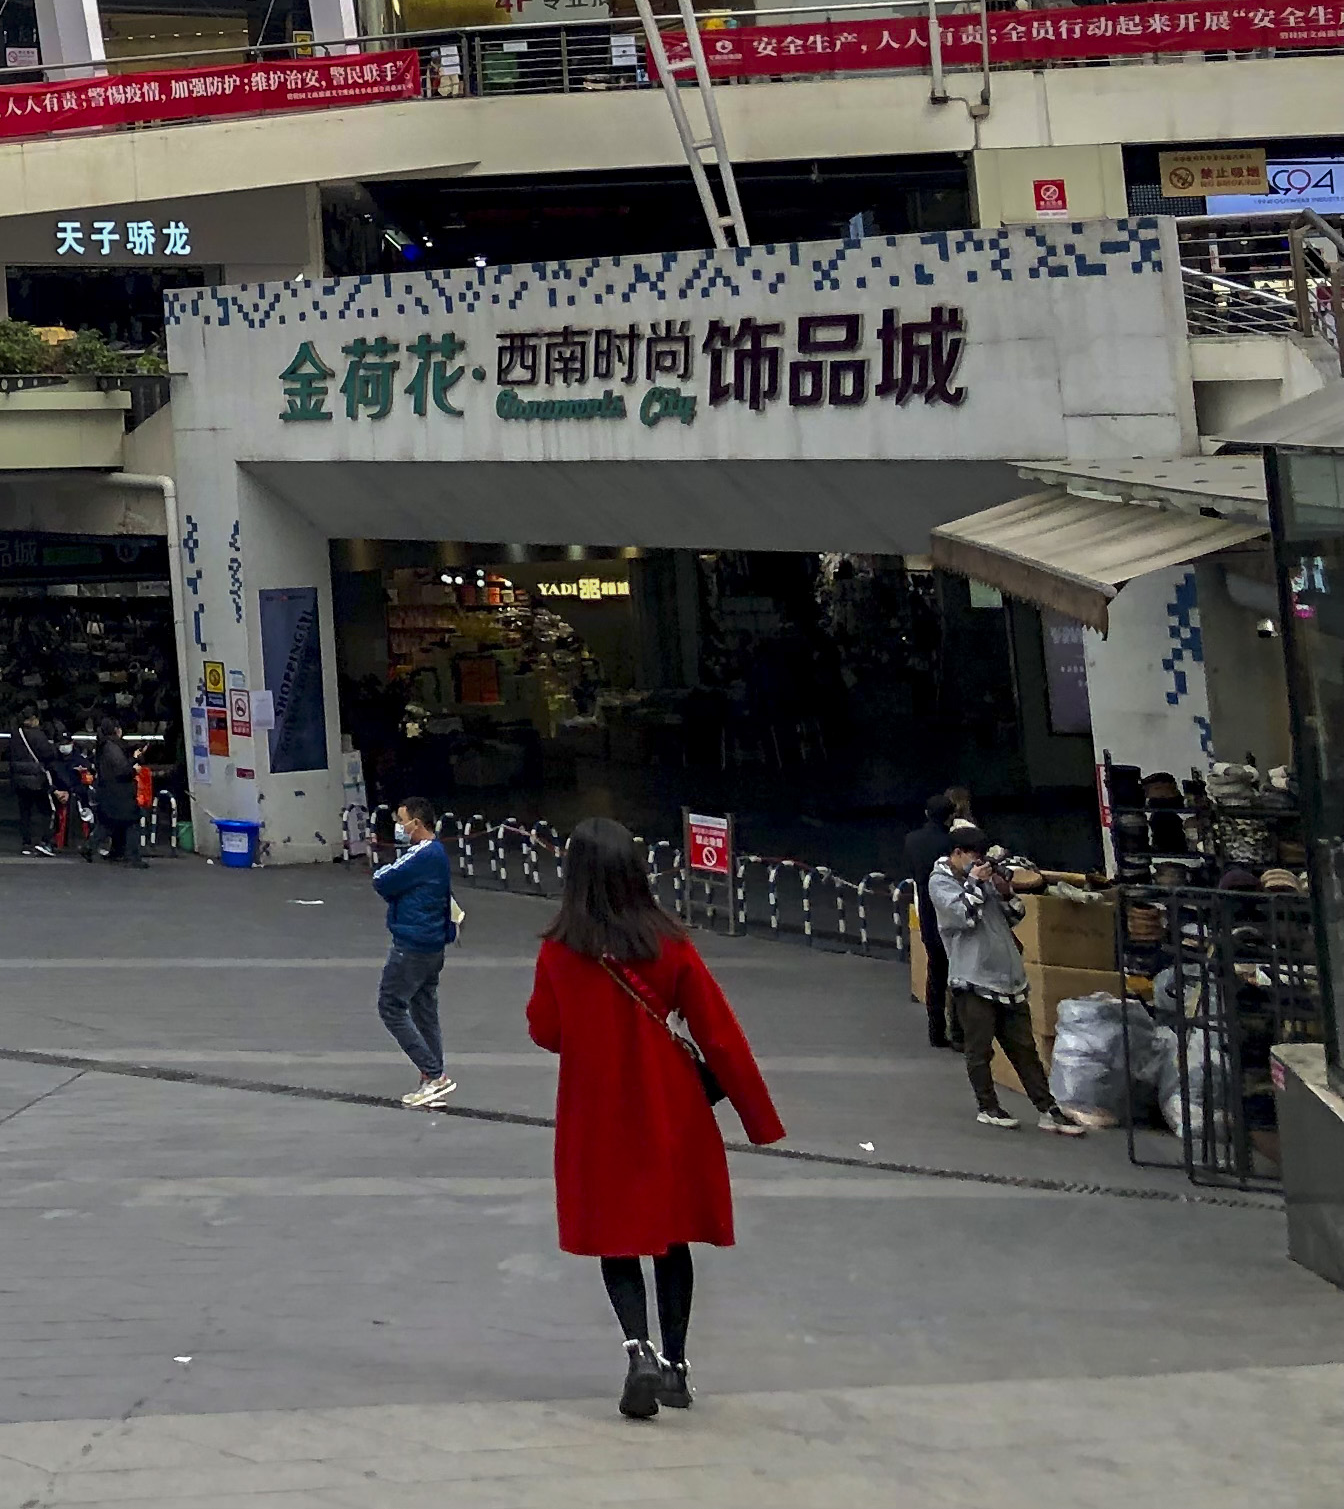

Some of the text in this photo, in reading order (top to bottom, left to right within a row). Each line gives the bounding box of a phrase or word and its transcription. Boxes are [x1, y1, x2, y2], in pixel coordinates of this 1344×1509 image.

[56, 221, 192, 255] 天子骄龙
[537, 583, 577, 595] YADI
